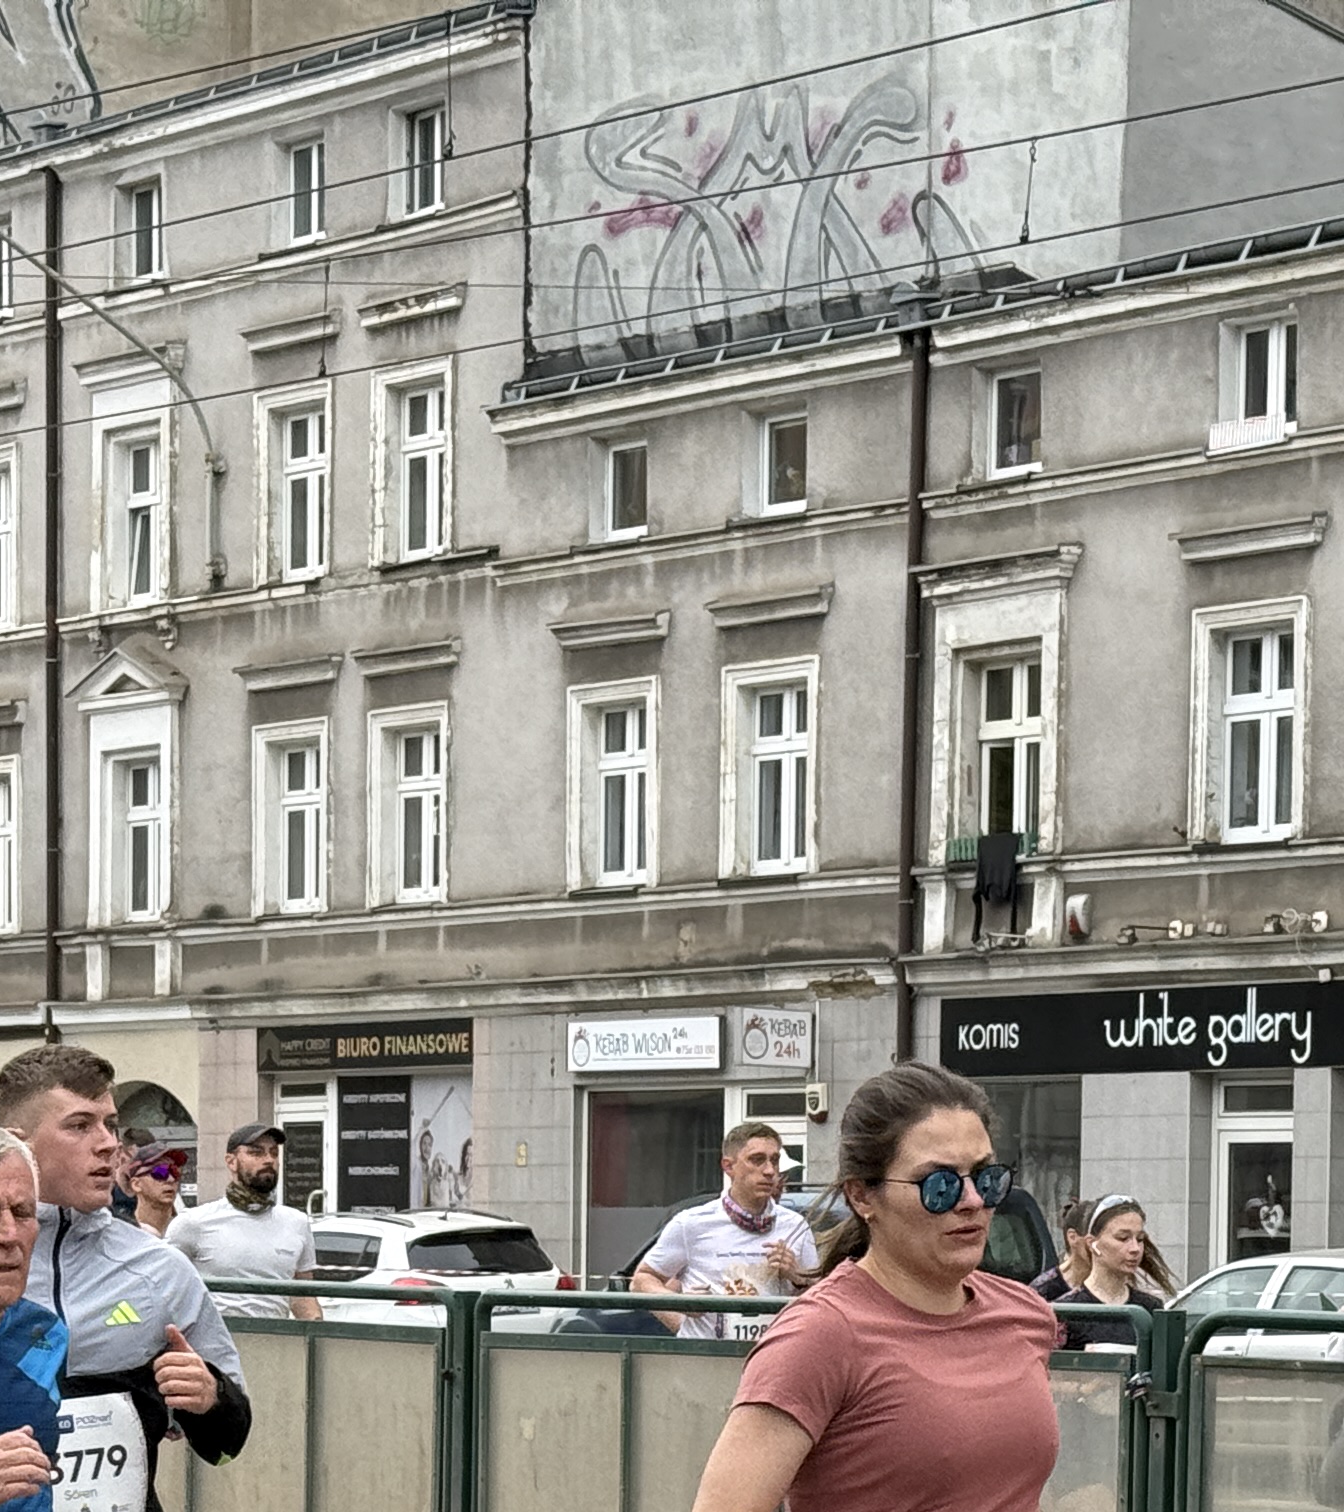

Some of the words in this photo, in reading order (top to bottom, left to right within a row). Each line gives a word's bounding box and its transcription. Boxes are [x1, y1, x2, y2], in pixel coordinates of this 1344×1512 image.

[769, 1017, 807, 1038] KEBAB
[958, 1023, 1020, 1050] KOMIS
[1103, 992, 1197, 1049] white
[1207, 987, 1312, 1067] gallery
[337, 1036, 380, 1058] BIURO
[384, 1032, 470, 1056] FINANSOWE
[593, 1033, 629, 1056] KEBAB
[632, 1032, 672, 1056] WILSON
[774, 1041, 801, 1059] 24h
